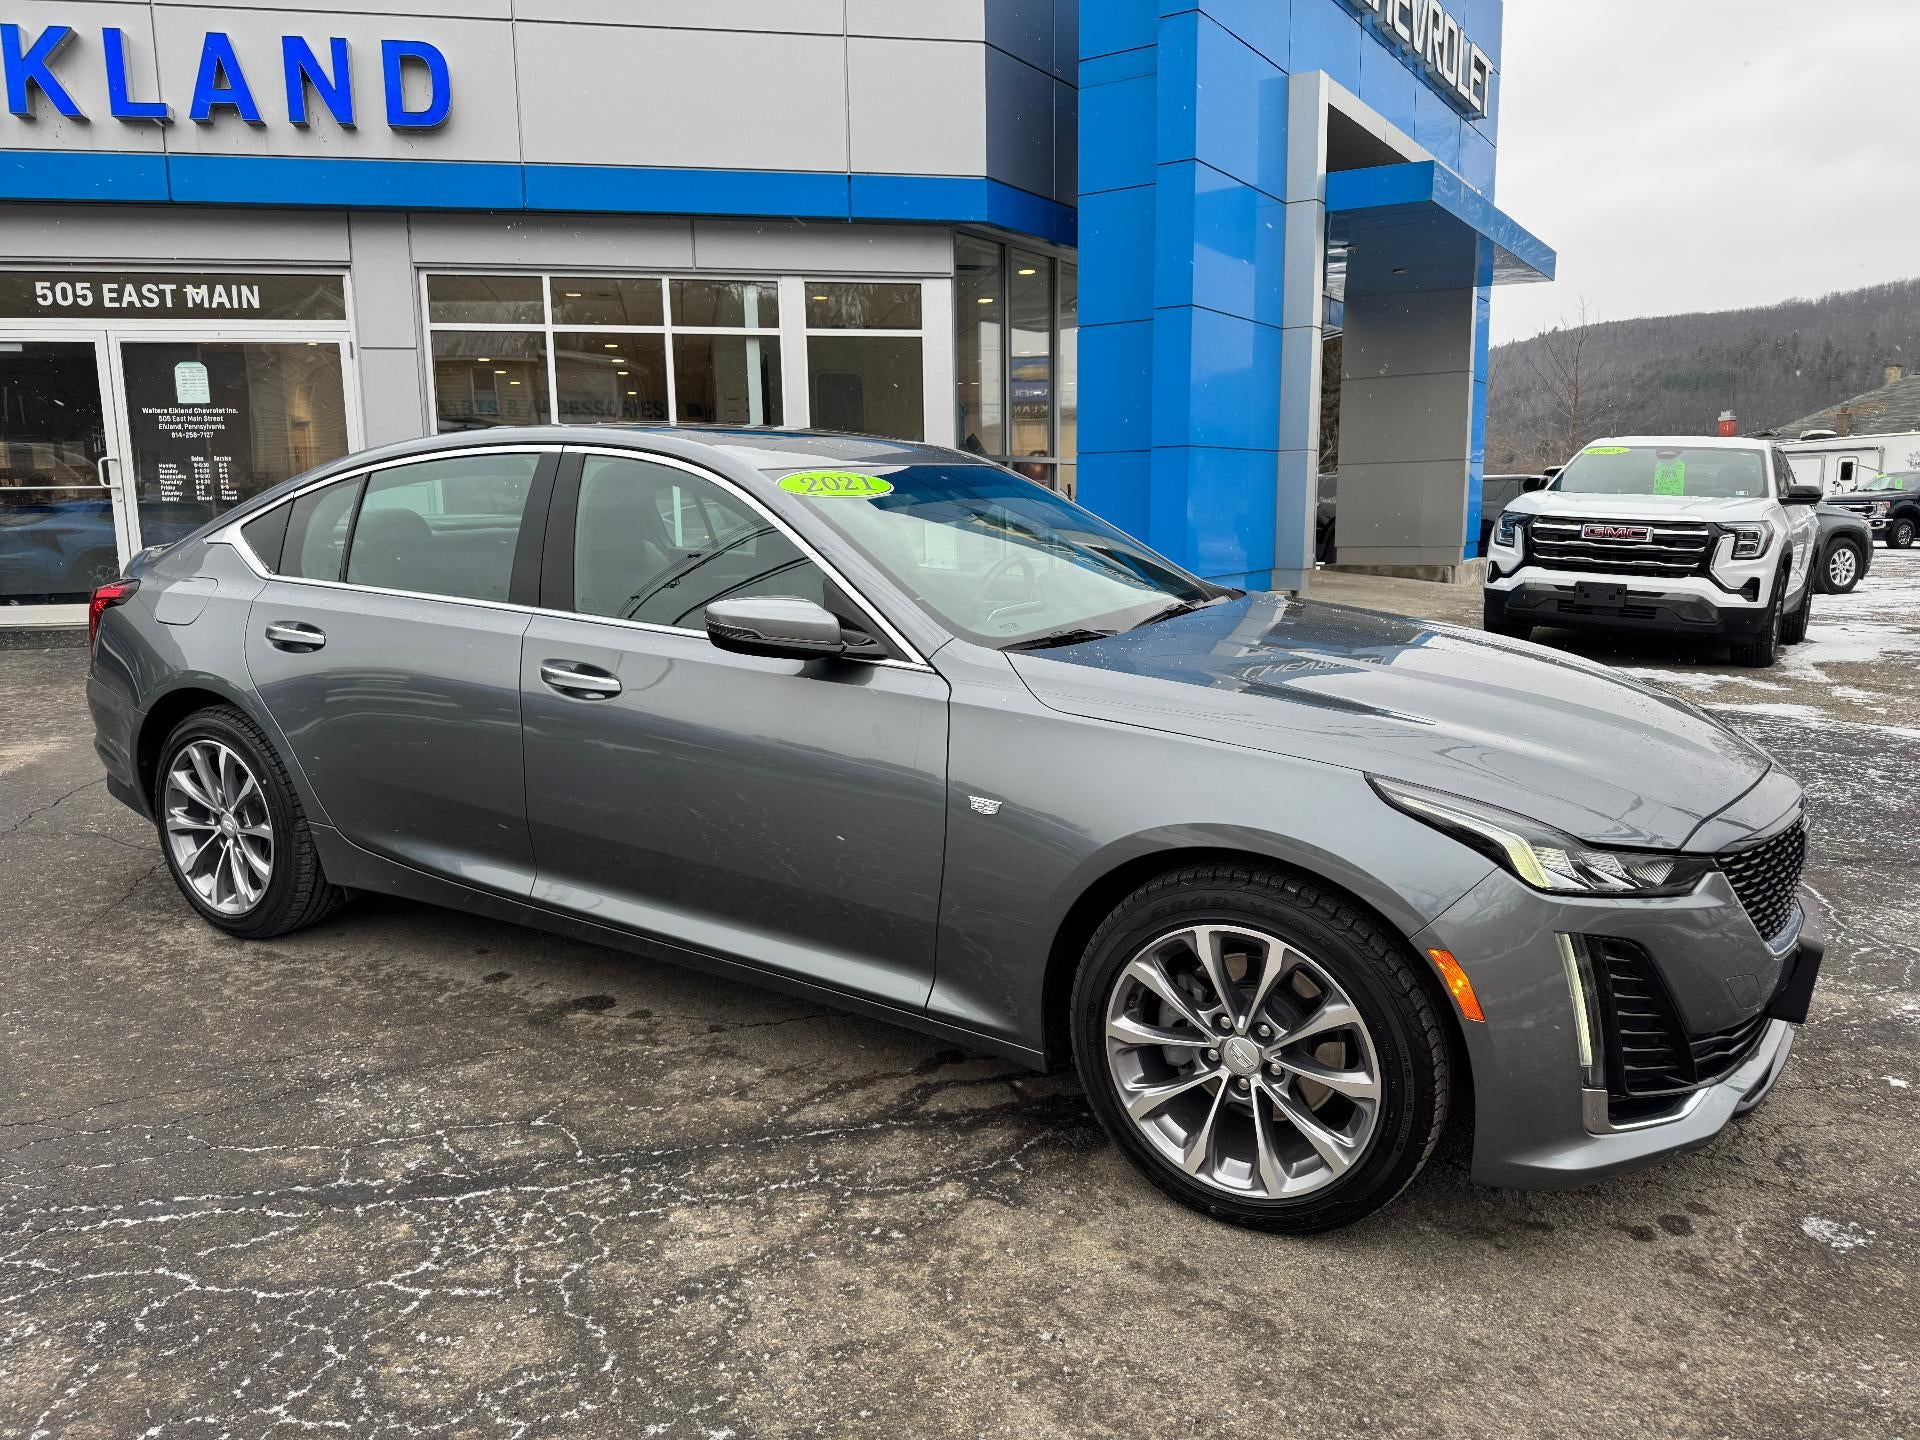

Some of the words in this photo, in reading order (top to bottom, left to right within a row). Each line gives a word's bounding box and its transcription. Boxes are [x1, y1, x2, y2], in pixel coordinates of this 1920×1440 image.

[1359, 0, 1493, 119] EVROLET
[0, 24, 451, 129] KLAND
[35, 282, 93, 306] 505
[102, 284, 176, 308] EAST
[186, 284, 260, 309] MAIN
[801, 476, 877, 492] 2021
[1585, 526, 1647, 540] GMC
